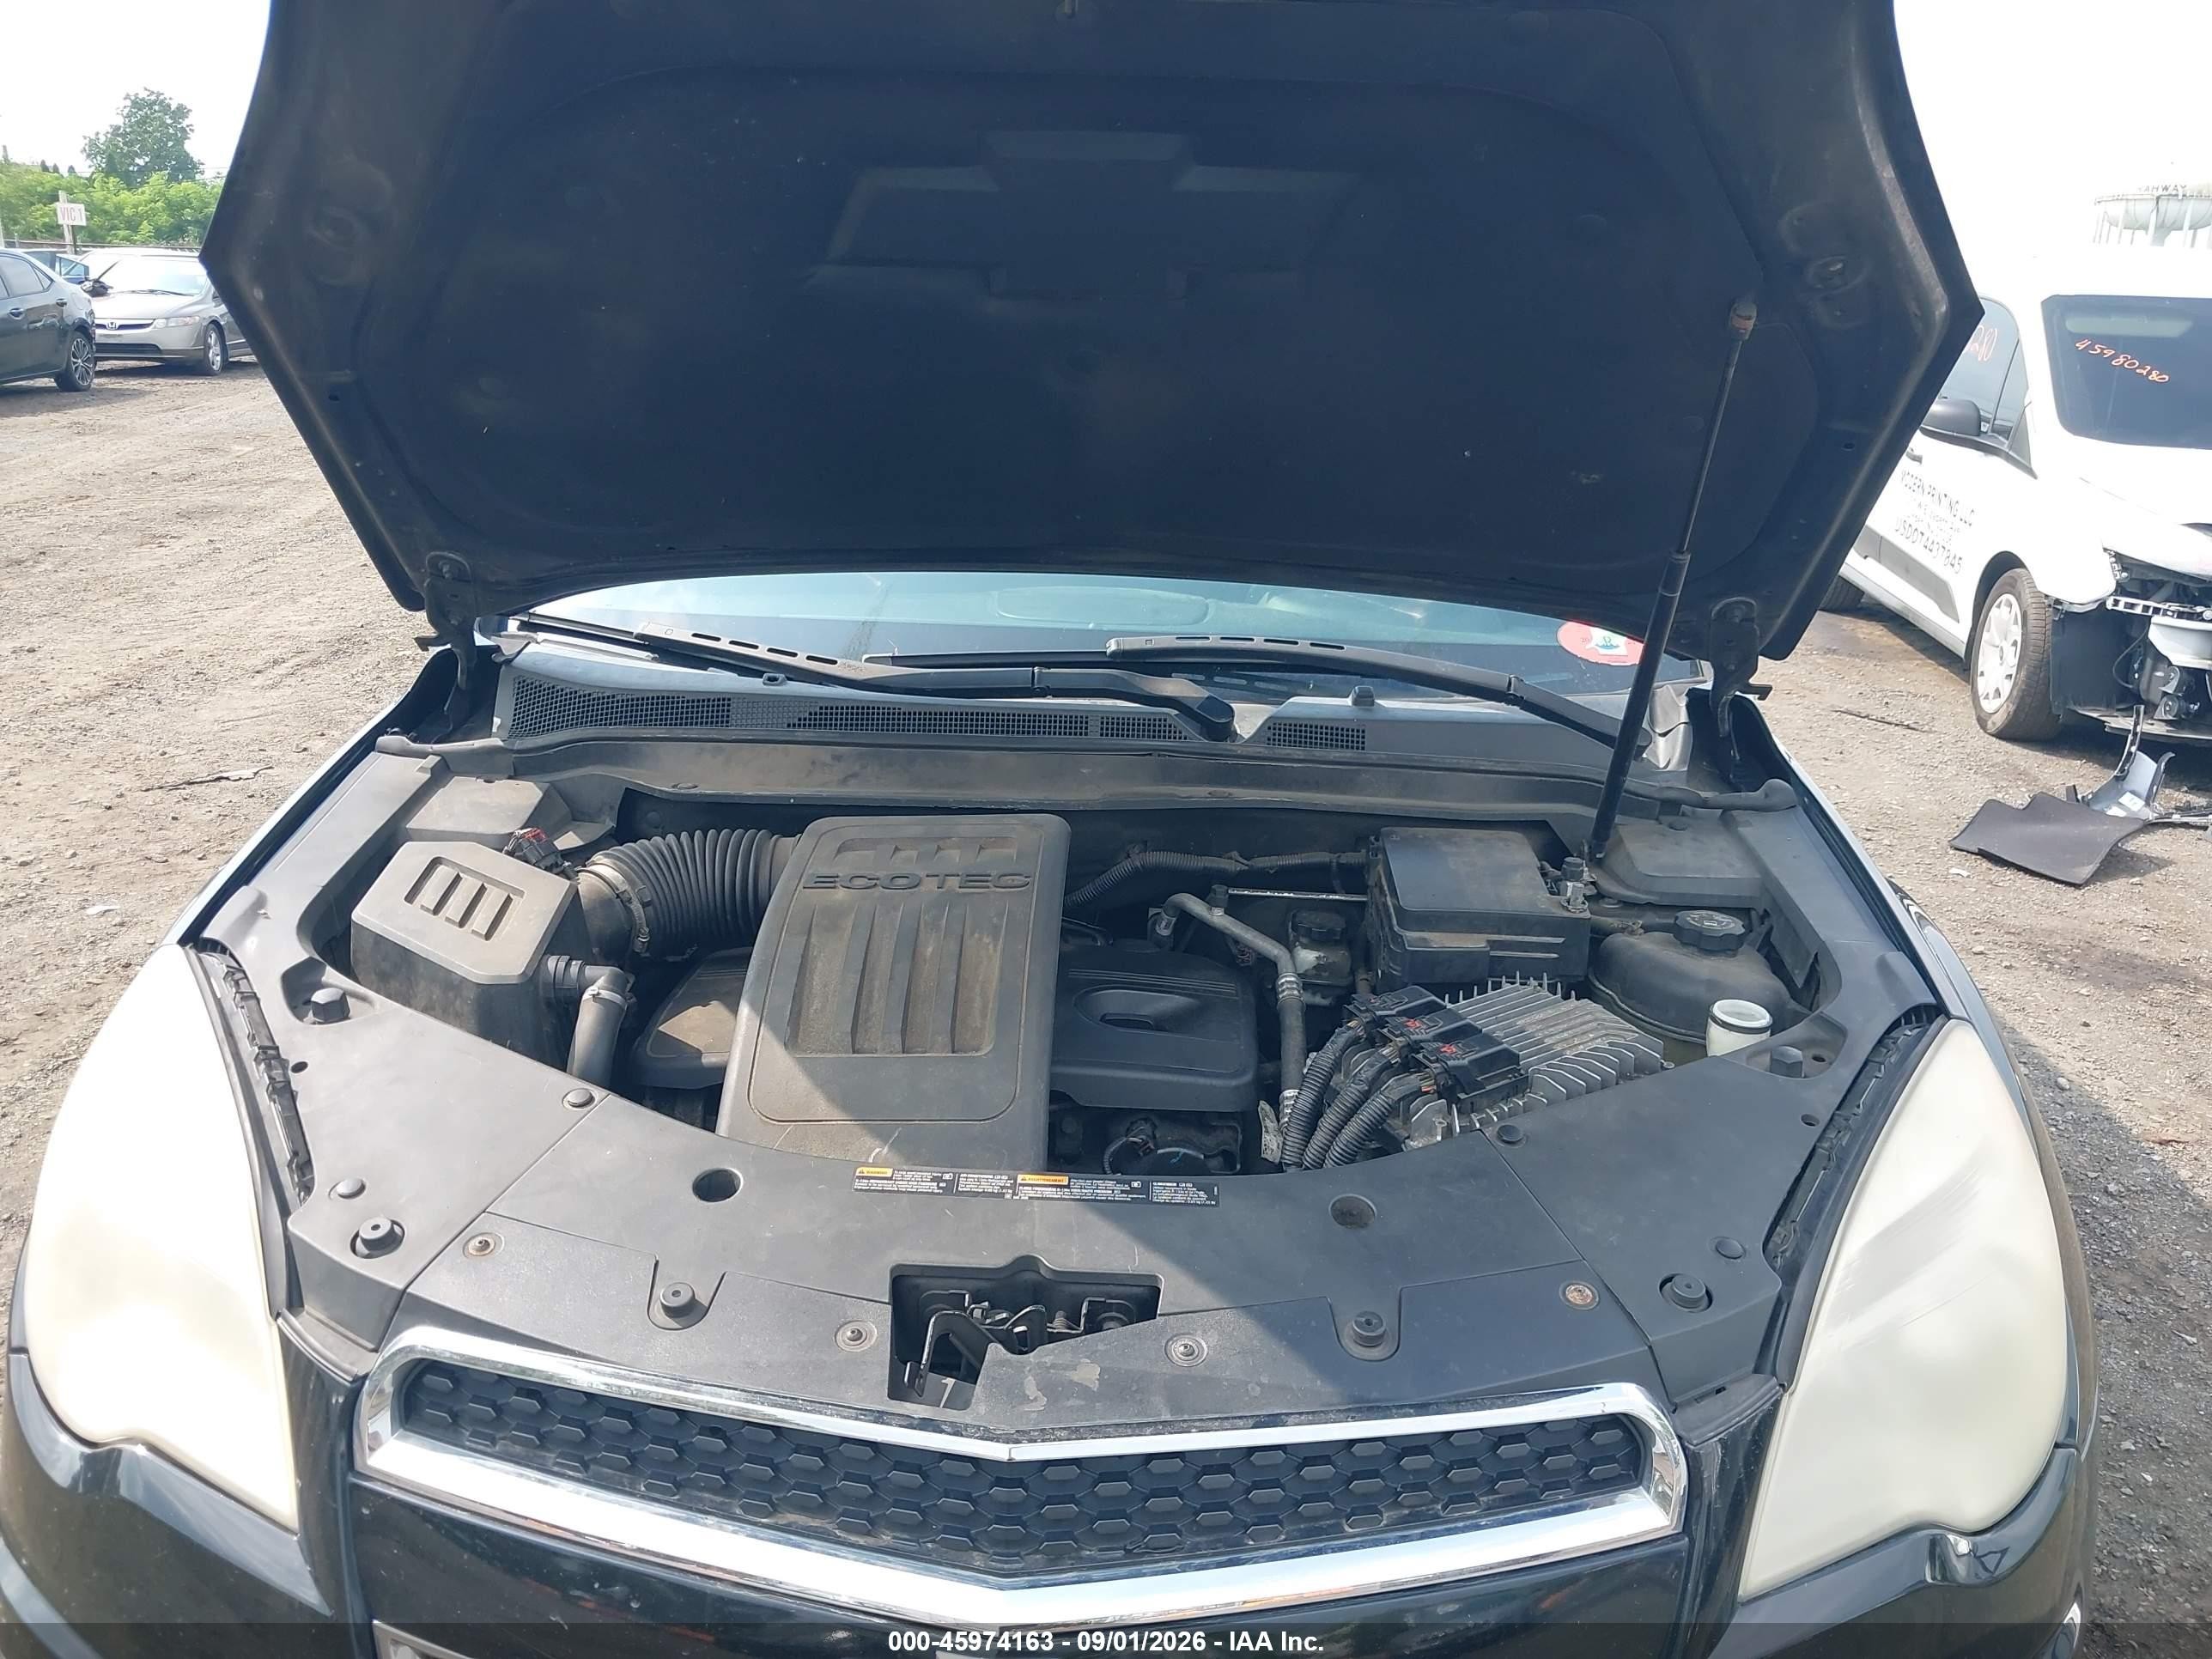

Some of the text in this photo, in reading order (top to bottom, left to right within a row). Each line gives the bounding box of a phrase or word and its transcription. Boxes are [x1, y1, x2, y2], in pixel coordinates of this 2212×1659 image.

[60, 207, 83, 222] VIC 1
[2075, 338, 2171, 383] 45980280
[802, 871, 1032, 890] ECOTEC
